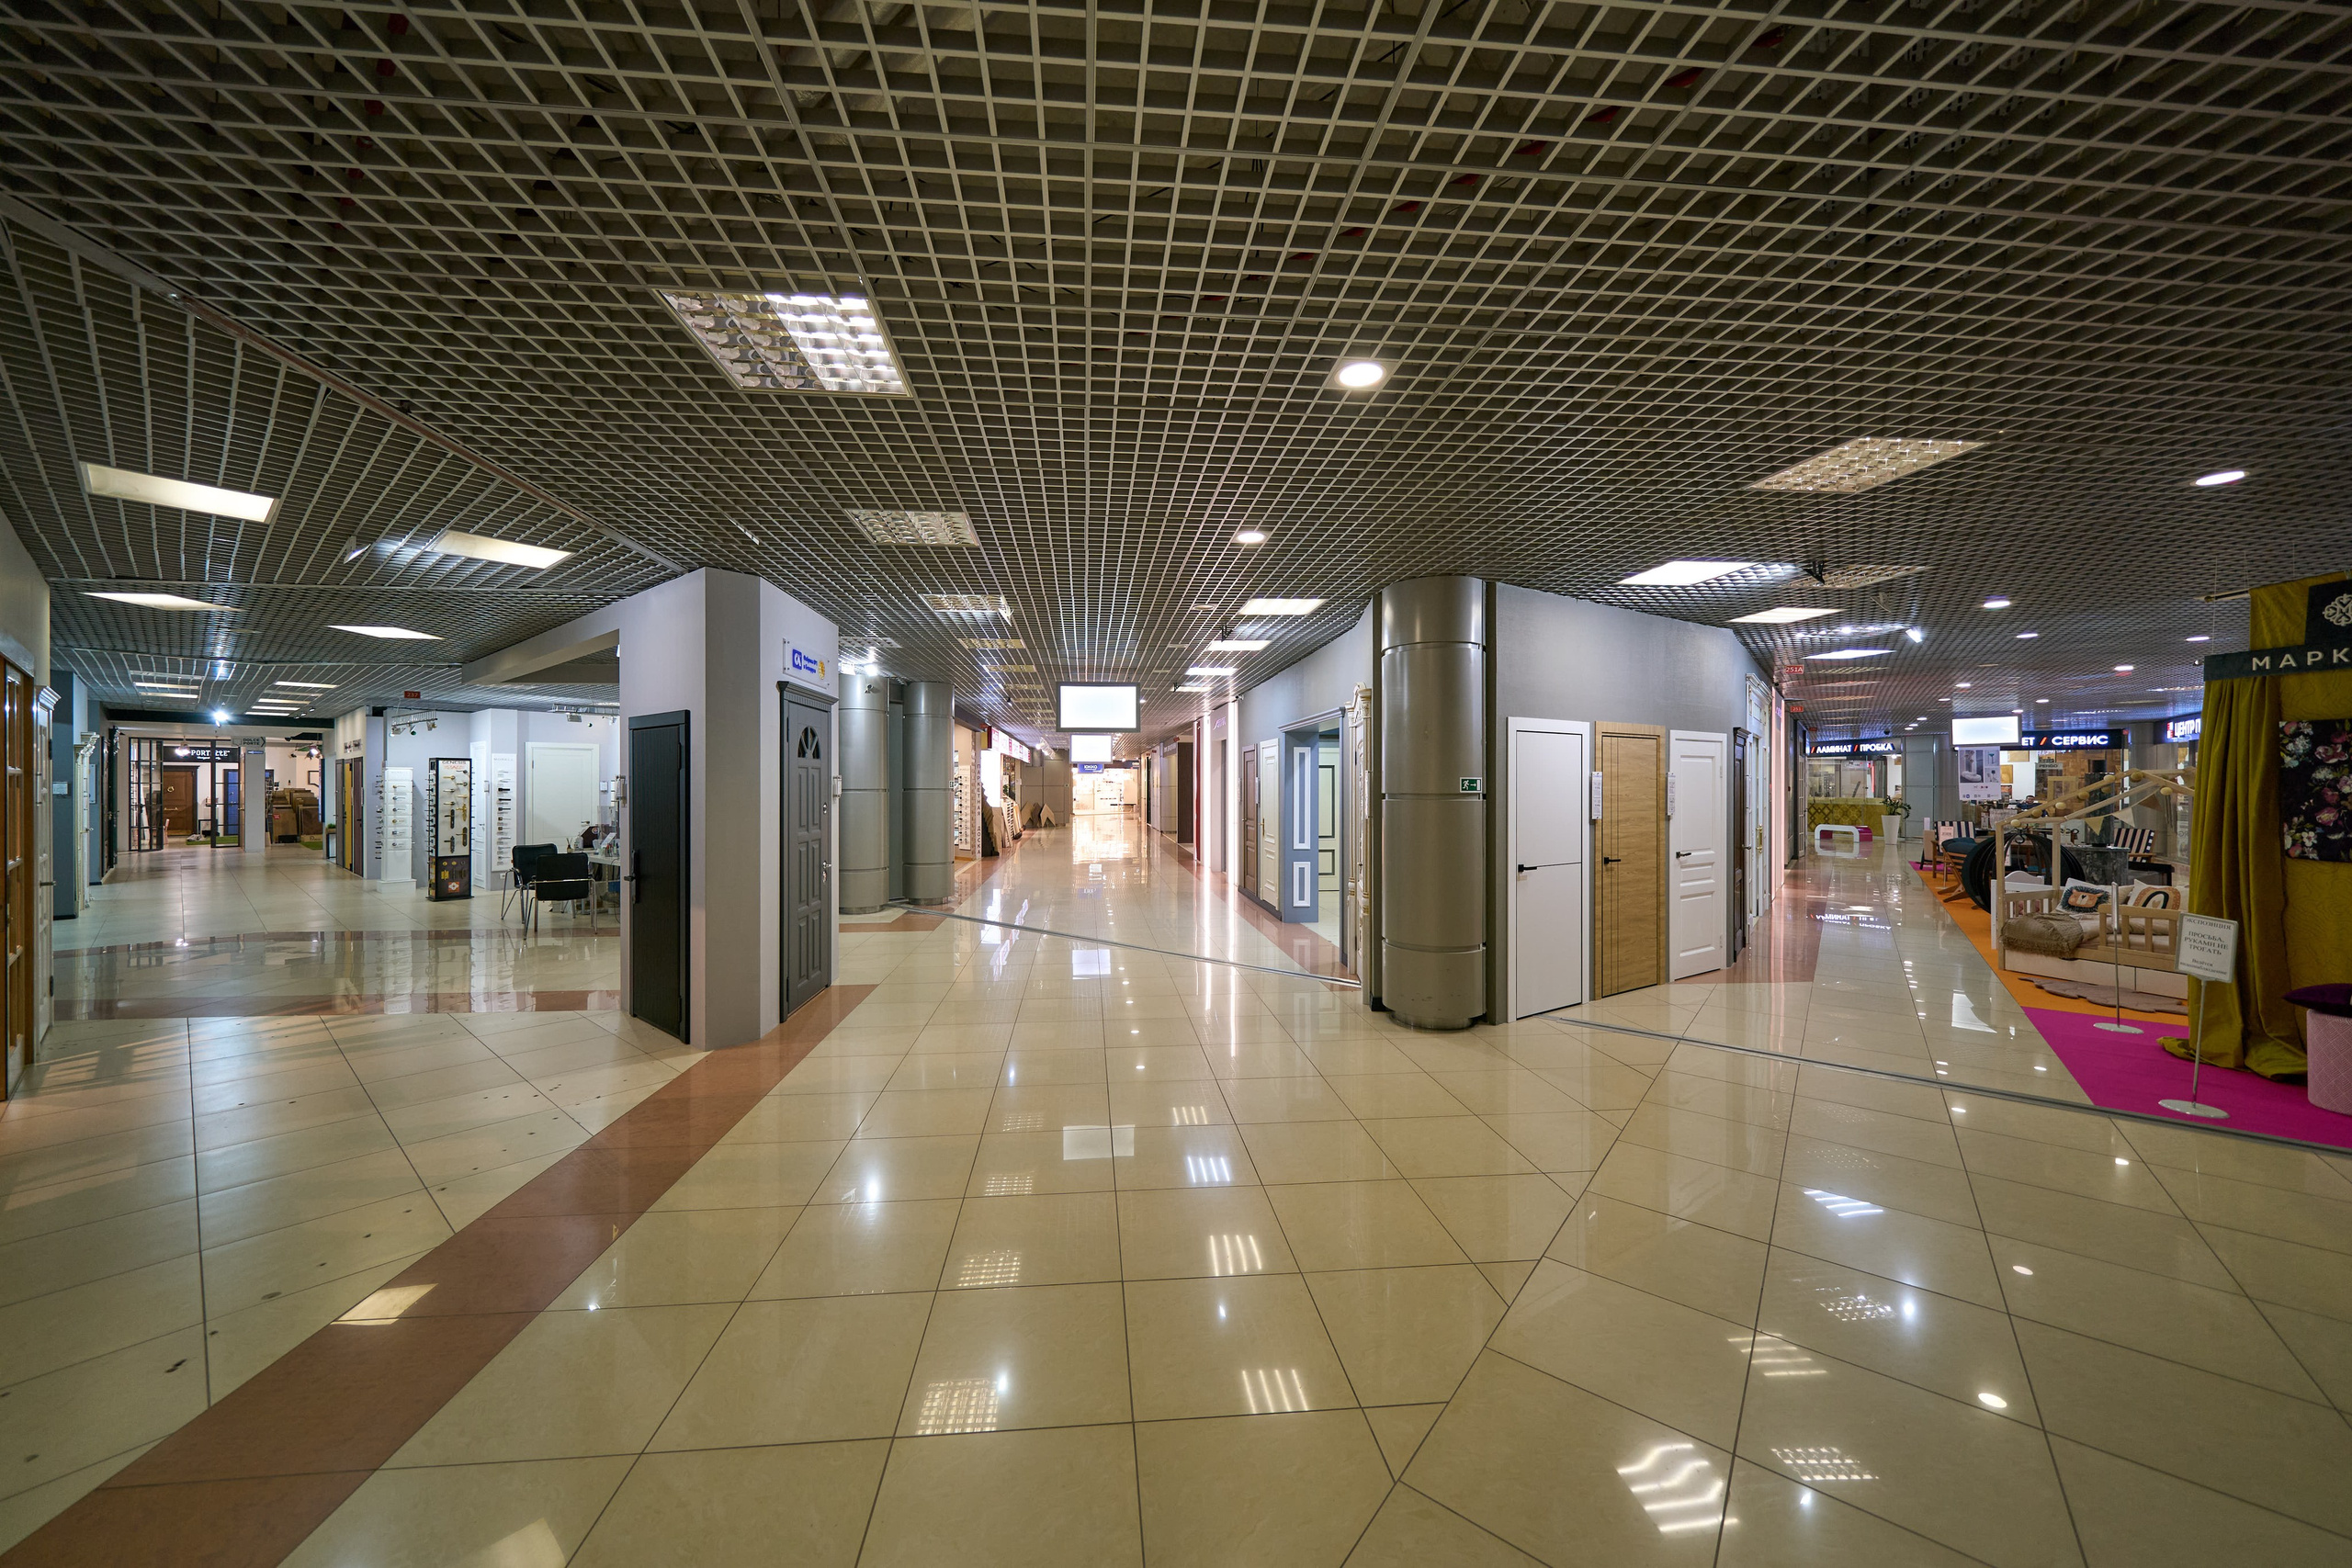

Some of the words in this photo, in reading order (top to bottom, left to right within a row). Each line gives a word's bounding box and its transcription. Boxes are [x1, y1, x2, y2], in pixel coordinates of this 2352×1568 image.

[2175, 719, 2195, 737] ЦЕНТР
[2052, 735, 2109, 745] СЕРВИС
[1816, 744, 1852, 753] ЛАМИНАТ
[1860, 743, 1893, 751] ПРОБКА
[2187, 919, 2232, 931] ЭКСПОЗИЦИЯ
[2185, 937, 2215, 948] РУКАМИ
[2189, 944, 2222, 955] ТРОГАТЬ
